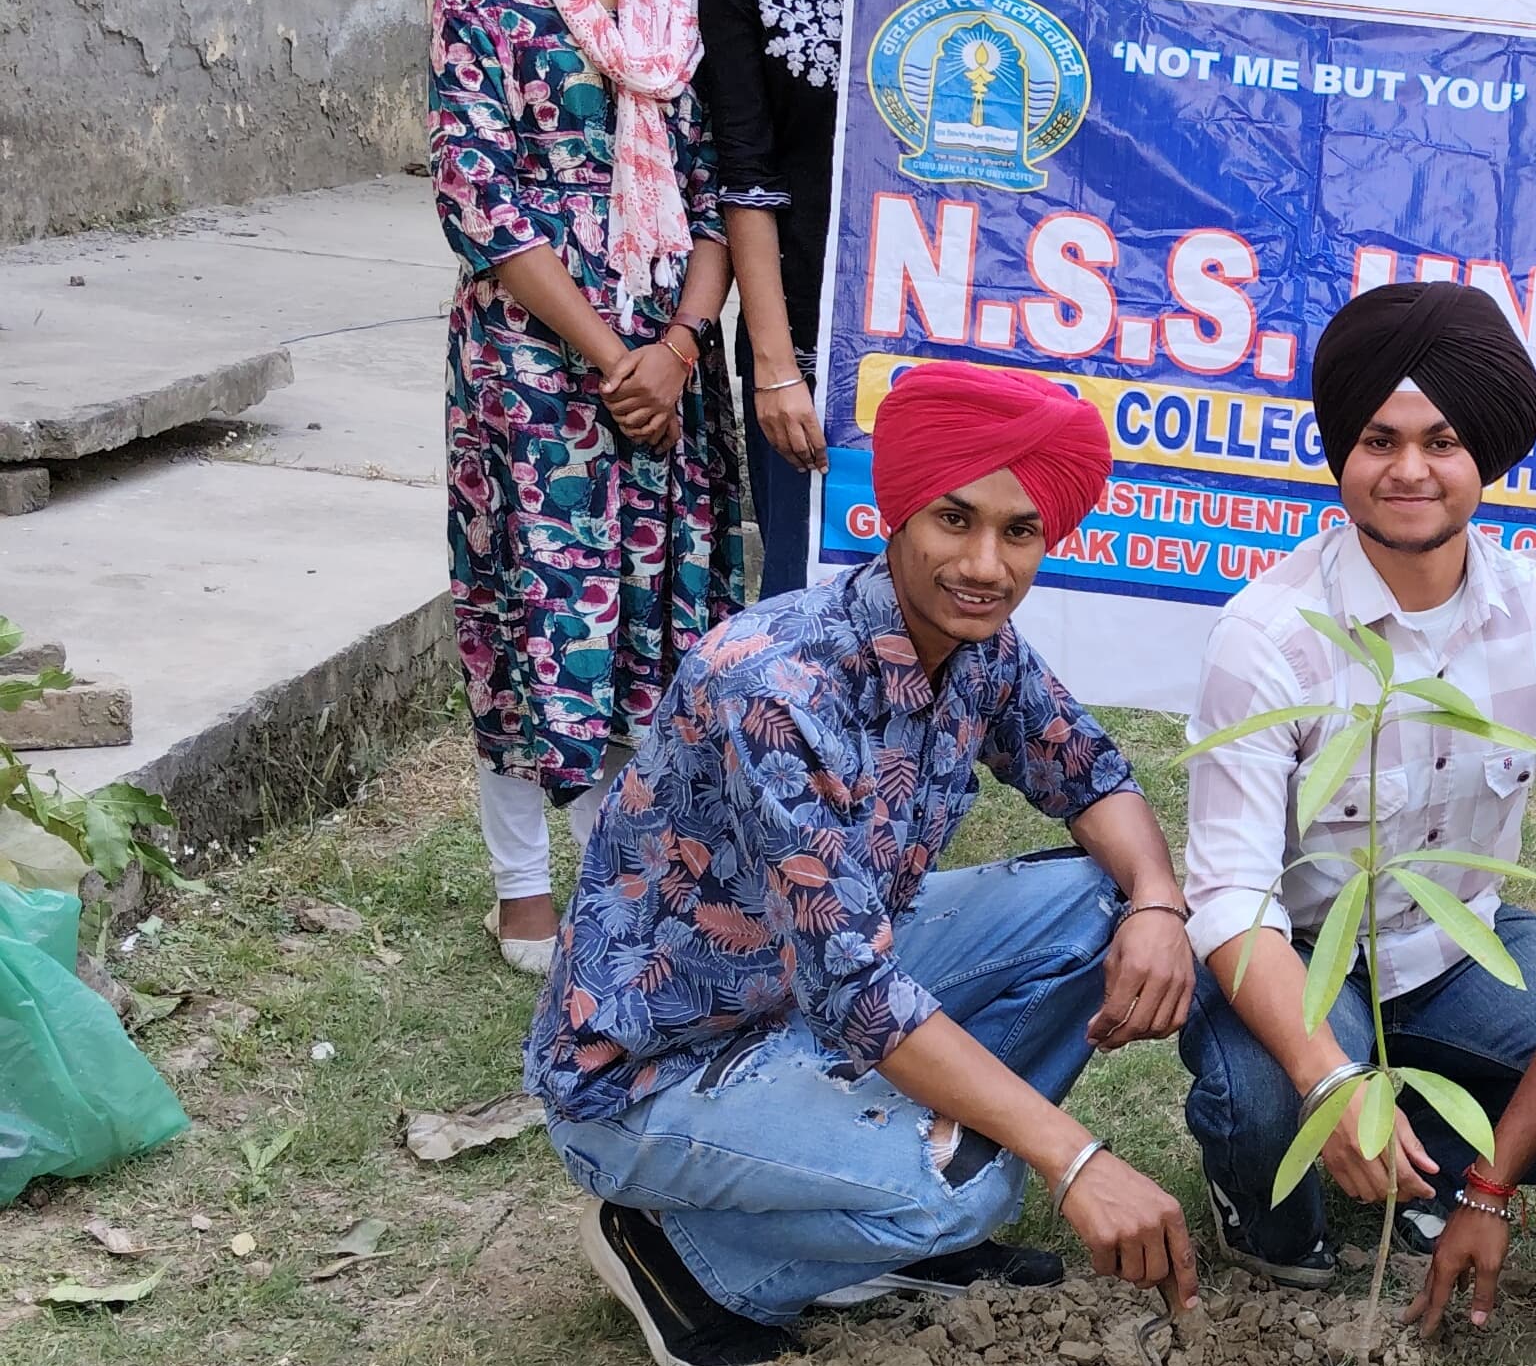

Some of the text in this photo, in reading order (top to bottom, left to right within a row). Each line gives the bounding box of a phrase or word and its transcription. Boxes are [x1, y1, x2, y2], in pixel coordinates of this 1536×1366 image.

[1233, 54, 1299, 91] ME
[1312, 63, 1405, 101] BUT
[864, 192, 1297, 381] N.S.S.
[1115, 389, 1329, 467] COLLEG
[1092, 481, 1309, 536] STITUENT
[1128, 534, 1209, 573] DEV
